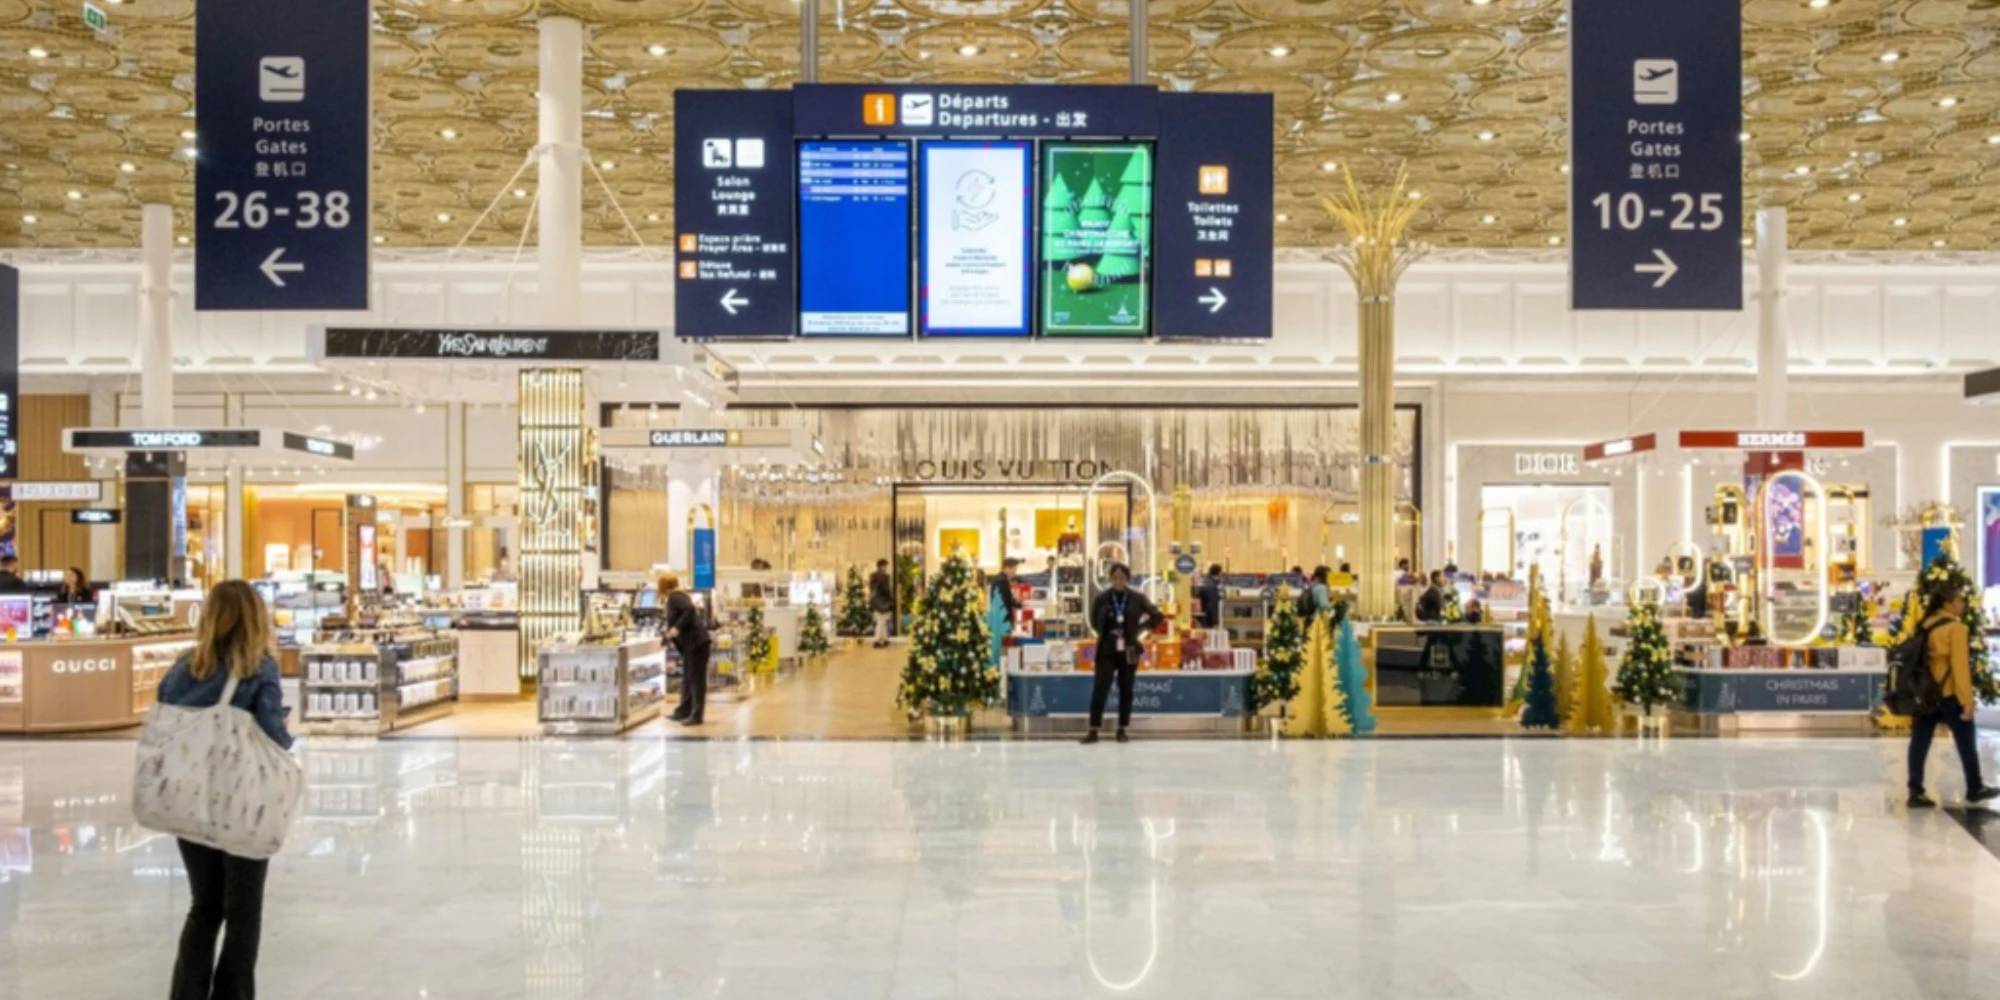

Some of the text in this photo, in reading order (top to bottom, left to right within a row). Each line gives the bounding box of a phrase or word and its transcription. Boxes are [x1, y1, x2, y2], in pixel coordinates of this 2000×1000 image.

[939, 93, 1009, 111] Départs
[253, 117, 310, 132] Portes
[939, 111, 1038, 130] Departures
[1627, 119, 1684, 135] Portes
[255, 139, 308, 154] Gates
[1631, 141, 1682, 157] Gates
[255, 162, 306, 177] 登机口
[1630, 163, 1680, 179] 登机口
[711, 189, 756, 202] Lounge
[214, 190, 351, 229] 26-38
[1187, 201, 1239, 213] Toilettes
[1592, 192, 1725, 231] 10-25
[1192, 215, 1233, 226] Toilets
[131, 432, 202, 446] TOM FORD
[651, 431, 725, 444] GUERLAIN
[903, 459, 986, 480] LOUIS
[1516, 453, 1579, 475] DIOR
[52, 658, 117, 673] GUCCI
[1765, 679, 1839, 691] CHRISTMAS
[1776, 693, 1828, 705] IN PARIS
